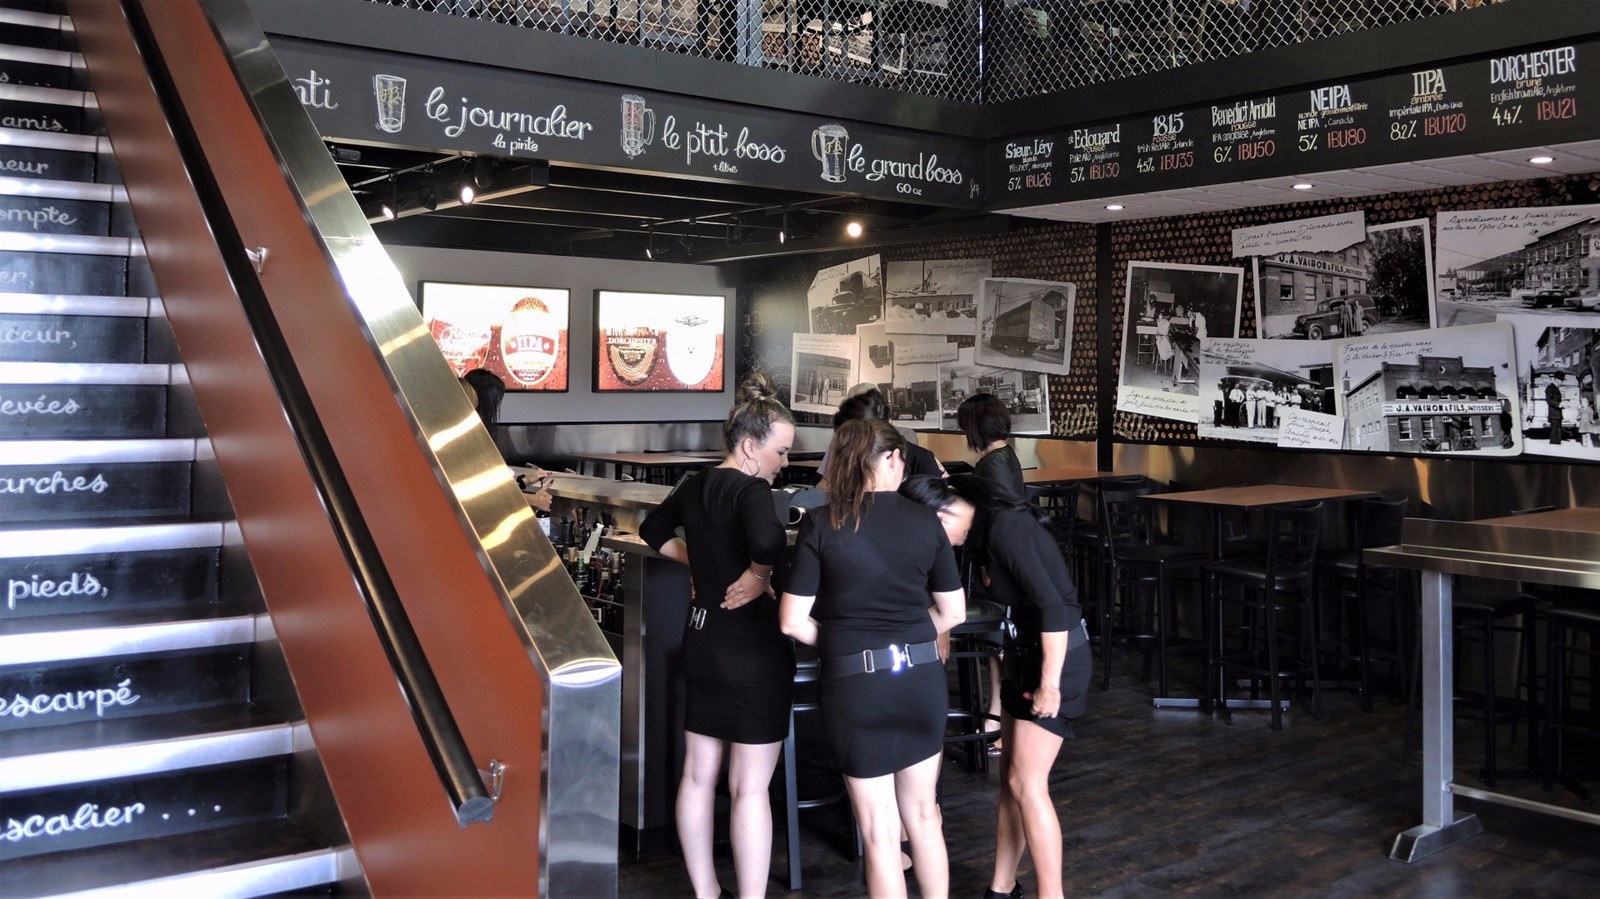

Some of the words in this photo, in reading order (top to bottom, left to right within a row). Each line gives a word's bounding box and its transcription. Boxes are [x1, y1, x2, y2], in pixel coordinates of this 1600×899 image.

[1490, 46, 1576, 84] DORCHESTER
[1411, 68, 1447, 97] IIPA
[1515, 78, 1543, 90] brune
[1310, 84, 1352, 112] NEIPA
[1490, 89, 1514, 105] English
[425, 86, 451, 122] le
[445, 97, 594, 140] journalier
[1211, 100, 1249, 127] Benedict
[1248, 96, 1276, 121] Arnold
[1327, 114, 1354, 127] Canada
[1492, 104, 1523, 127] 4.4%
[2, 115, 69, 132] amis.
[1152, 112, 1184, 137] 1815
[1231, 120, 1257, 132] rousse
[1424, 112, 1466, 136] IBU120
[492, 133, 506, 149] la
[510, 136, 539, 156] pinte
[662, 115, 681, 150] le
[686, 121, 729, 165] p'tit
[733, 126, 787, 164] boss
[1073, 123, 1121, 149] Edouard
[1152, 133, 1177, 143] rousse
[1298, 133, 1318, 152] 5%
[1327, 127, 1367, 149] IBU80
[1069, 152, 1081, 164] Pale
[1083, 144, 1106, 153] rousse
[1213, 145, 1232, 163] 6%
[1238, 139, 1276, 161] IBU50
[718, 161, 738, 173] litre
[847, 143, 866, 173] le
[865, 152, 923, 181] grand
[925, 154, 963, 184] boss
[1160, 151, 1194, 171] IBU35
[1007, 176, 1022, 191] 5%
[1025, 171, 1052, 188] IBU26
[1069, 166, 1086, 183] 5%
[896, 182, 912, 194] 60
[912, 187, 923, 196] oz
[0, 329, 77, 349] ceur,
[0, 394, 81, 415] evées
[8, 572, 108, 609] pieds,
[0, 678, 141, 717] escarpé
[0, 803, 145, 842] scalier
